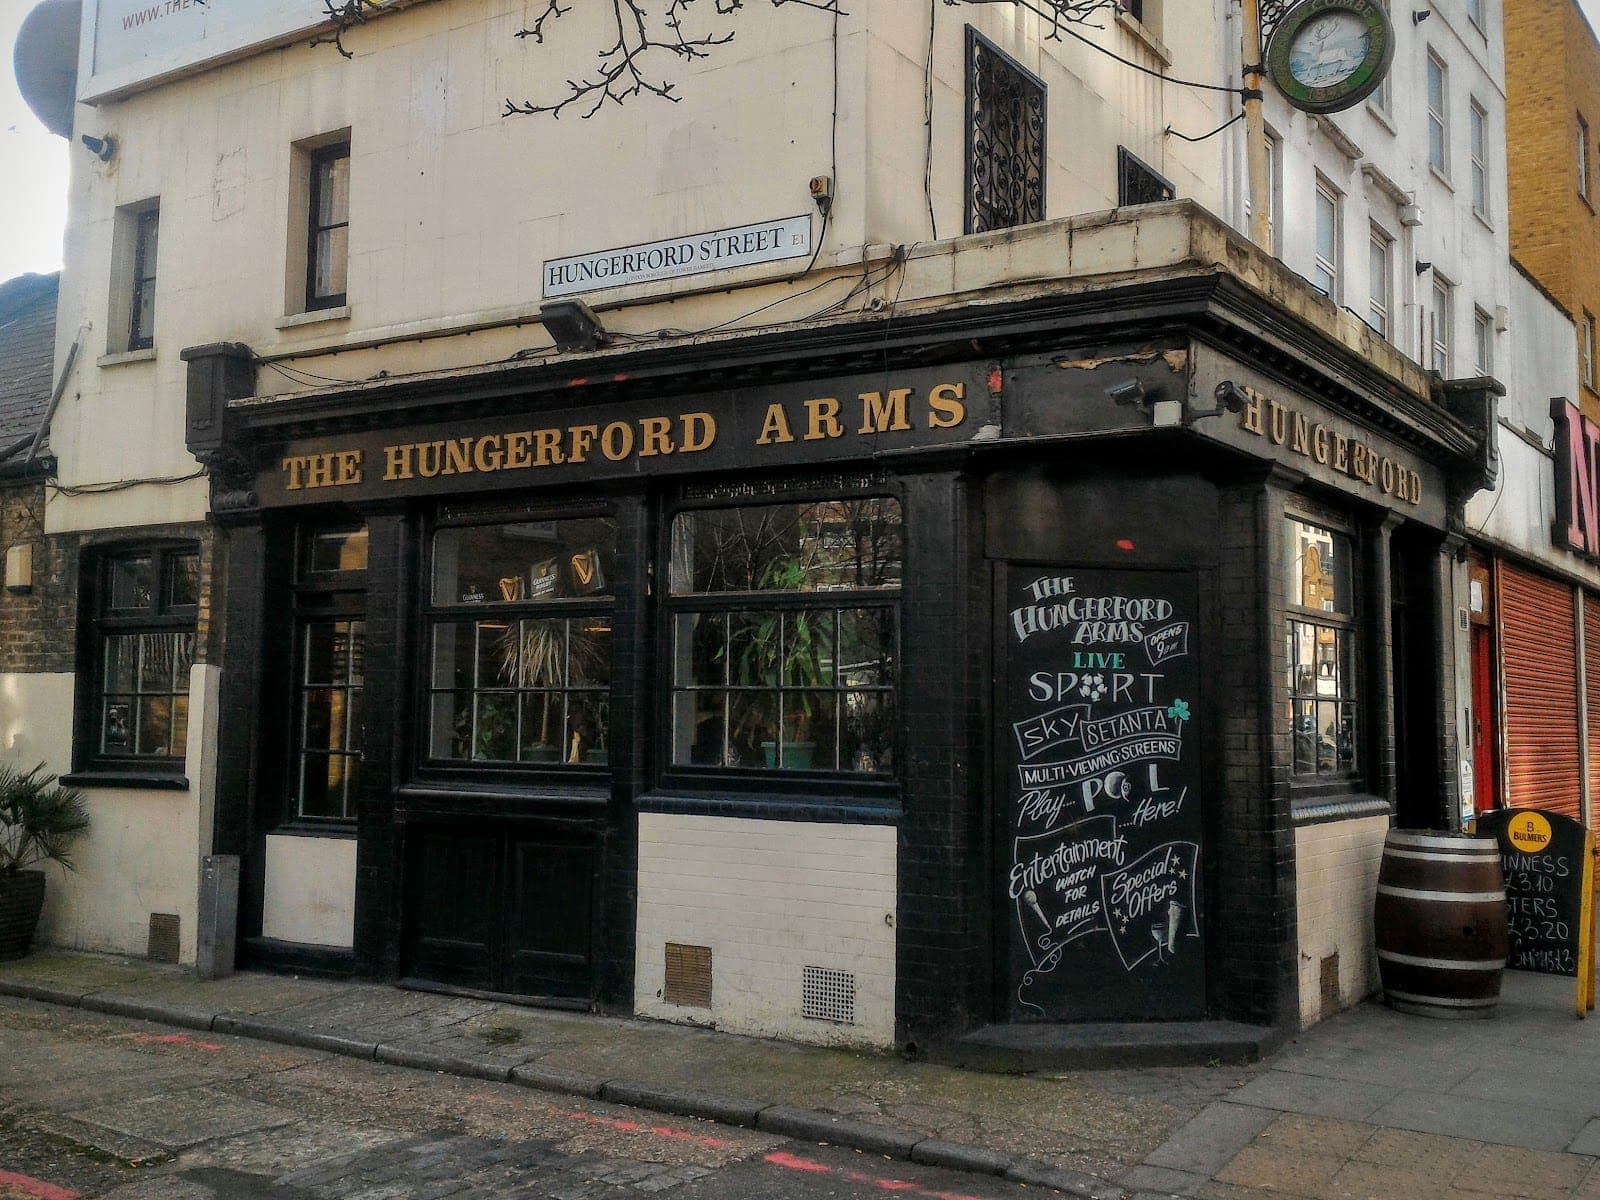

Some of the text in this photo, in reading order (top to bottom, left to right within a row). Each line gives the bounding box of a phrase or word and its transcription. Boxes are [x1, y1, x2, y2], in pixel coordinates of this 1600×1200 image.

[548, 227, 804, 286] HUNGERFORD STREET E1
[282, 382, 967, 490] THE HUNGERFORD ARMS
[1240, 386, 1422, 505] HUNGERFORD
[1023, 575, 1076, 601] THE
[1010, 596, 1173, 643] HUNGERFORD
[1071, 621, 1145, 645] ARMS
[1150, 624, 1183, 646] OPENS
[1072, 652, 1126, 670] LIVE
[1023, 710, 1168, 747] SKY SETANTA
[1513, 831, 1547, 843] BULMERS
[1009, 834, 1128, 899] Entertainment
[1056, 865, 1097, 892] WATCH
[1111, 846, 1173, 904] Special
[1502, 853, 1569, 877] INNESS
[1065, 886, 1088, 903] FOR
[1128, 880, 1177, 919] Offers
[1056, 901, 1100, 928] DETAILS
